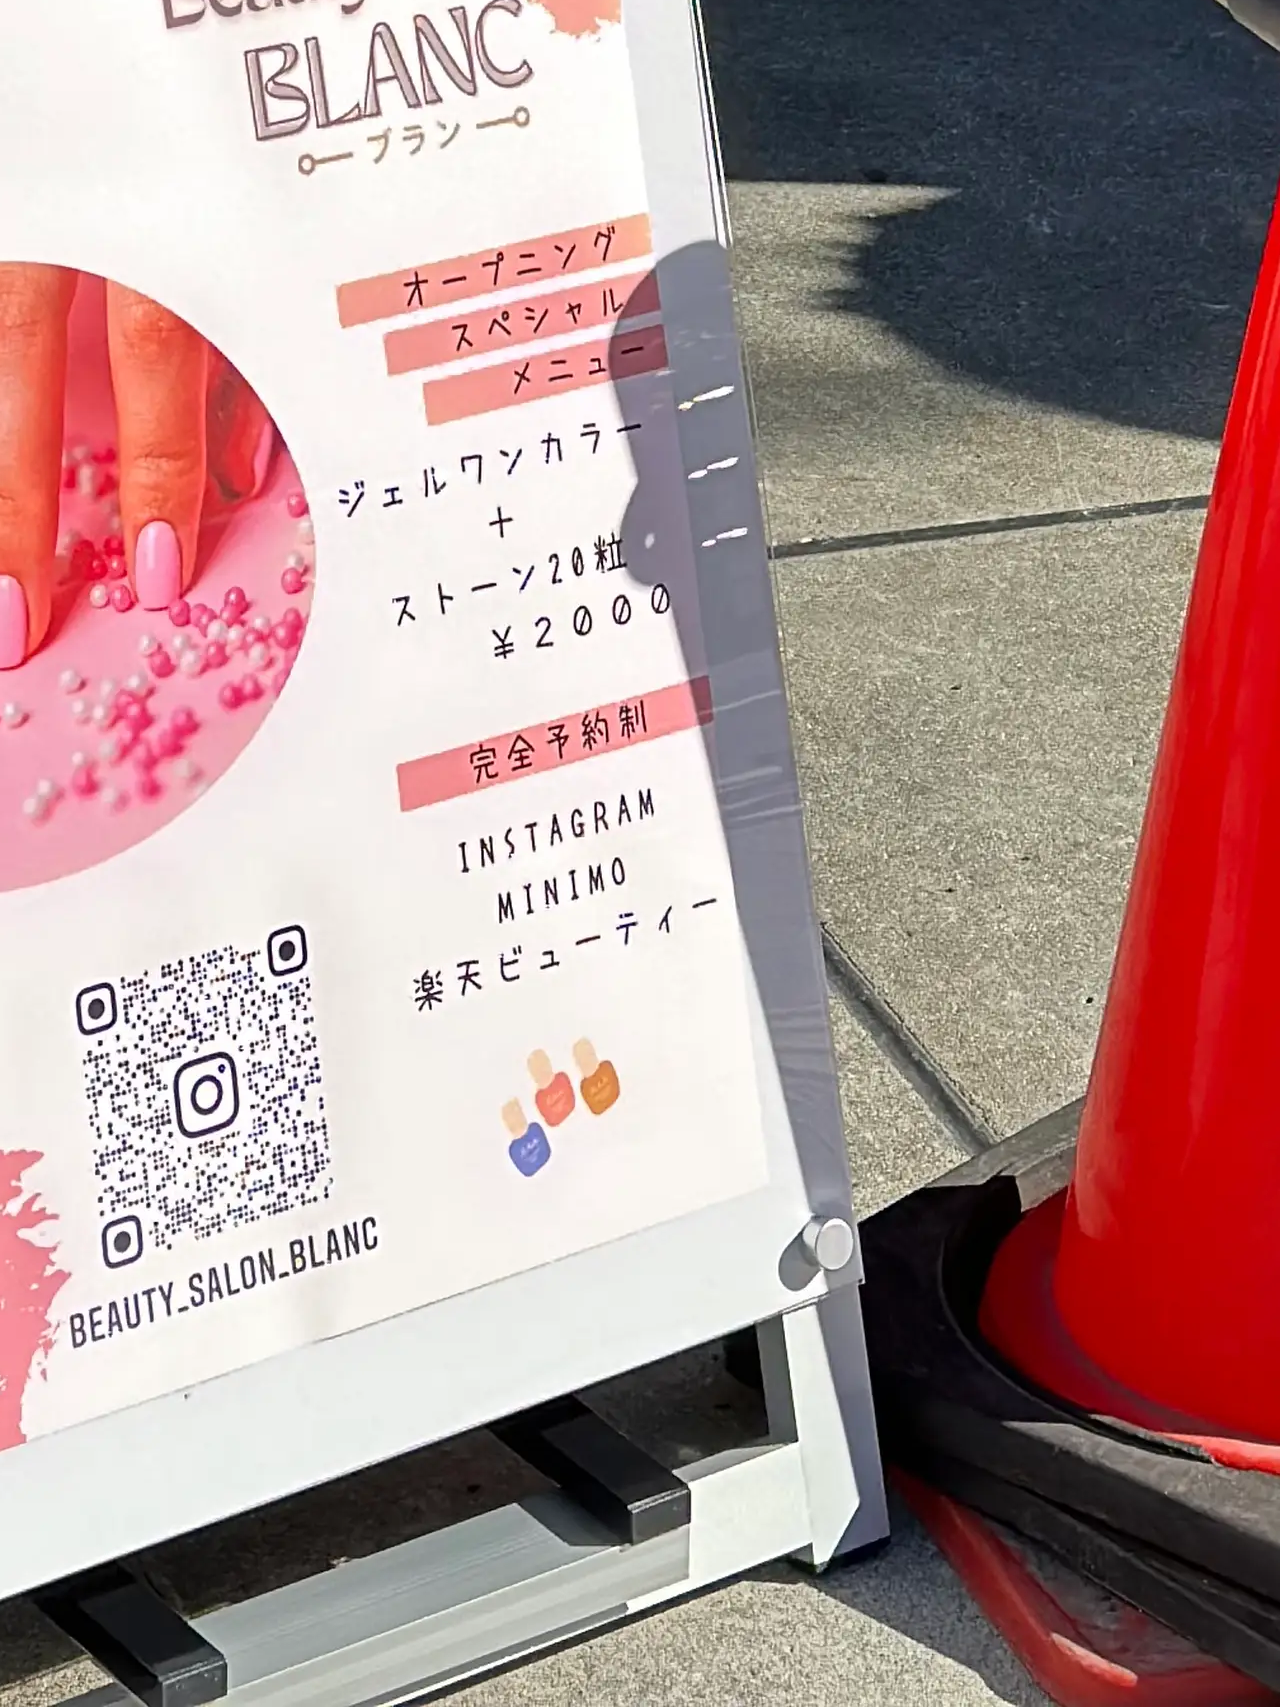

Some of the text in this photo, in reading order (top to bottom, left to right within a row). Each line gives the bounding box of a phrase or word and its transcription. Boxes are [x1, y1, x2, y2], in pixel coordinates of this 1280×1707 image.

[367, 122, 461, 164] ブラン
[403, 226, 616, 307] オープニング
[451, 288, 624, 352] スペシャル
[512, 345, 645, 394] メニュー
[338, 423, 642, 518] ジェルワンカラー
[392, 532, 628, 627] ストーン20粒
[492, 584, 671, 660] ¥2000
[469, 700, 648, 784] 完全予約制
[459, 788, 656, 874] INSTAGRAM
[497, 857, 627, 924] MINIMO
[413, 898, 718, 1012] 楽天ビューティー
[69, 1216, 379, 1349] BEAUTY_SALON_BLANC
